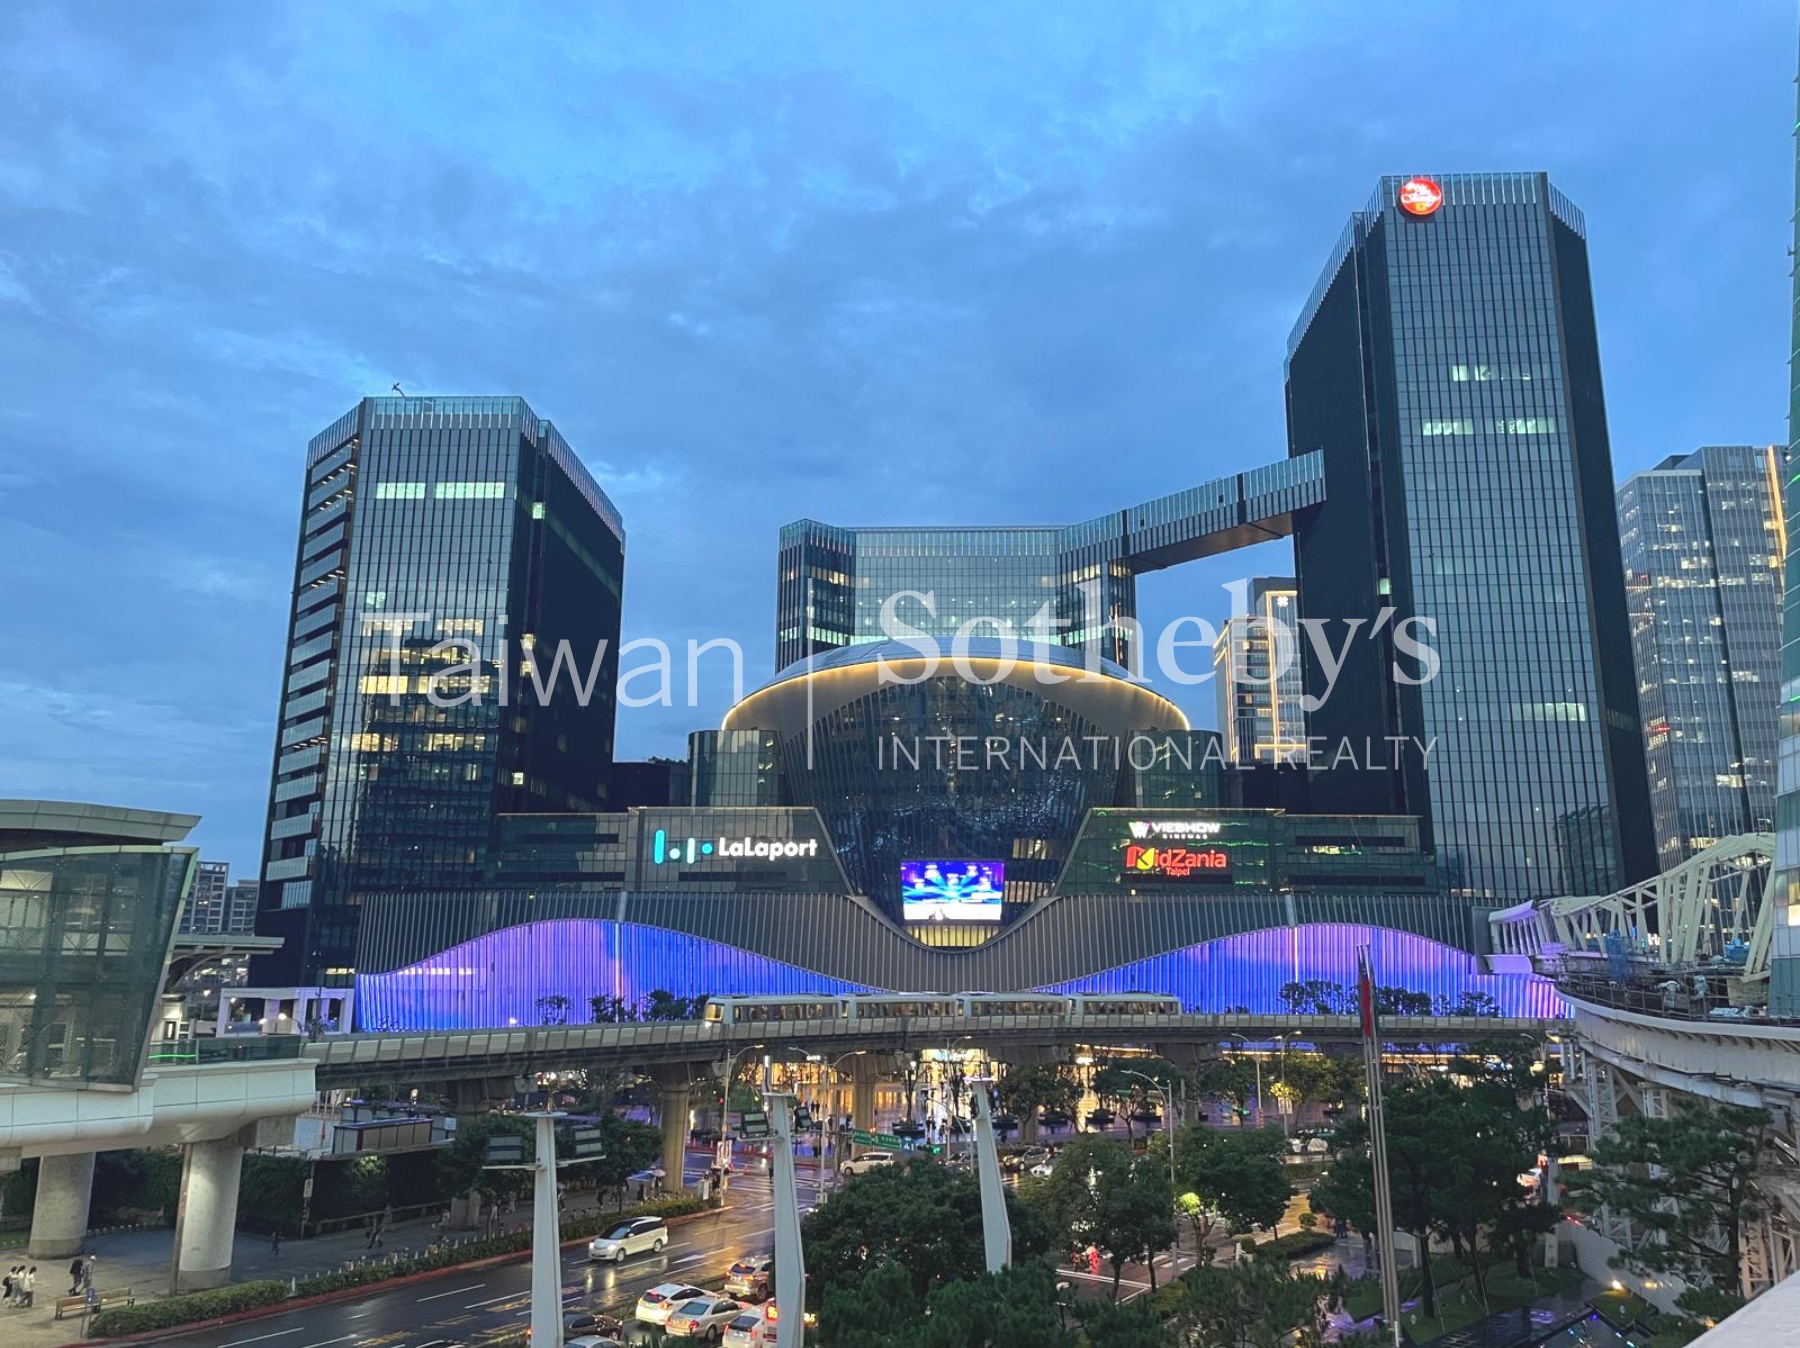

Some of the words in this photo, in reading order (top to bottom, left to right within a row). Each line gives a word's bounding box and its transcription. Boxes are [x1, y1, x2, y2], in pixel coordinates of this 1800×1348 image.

[718, 836, 818, 862] LaLaport
[1126, 845, 1227, 870] KidZania
[1165, 867, 1190, 877] Taipei
